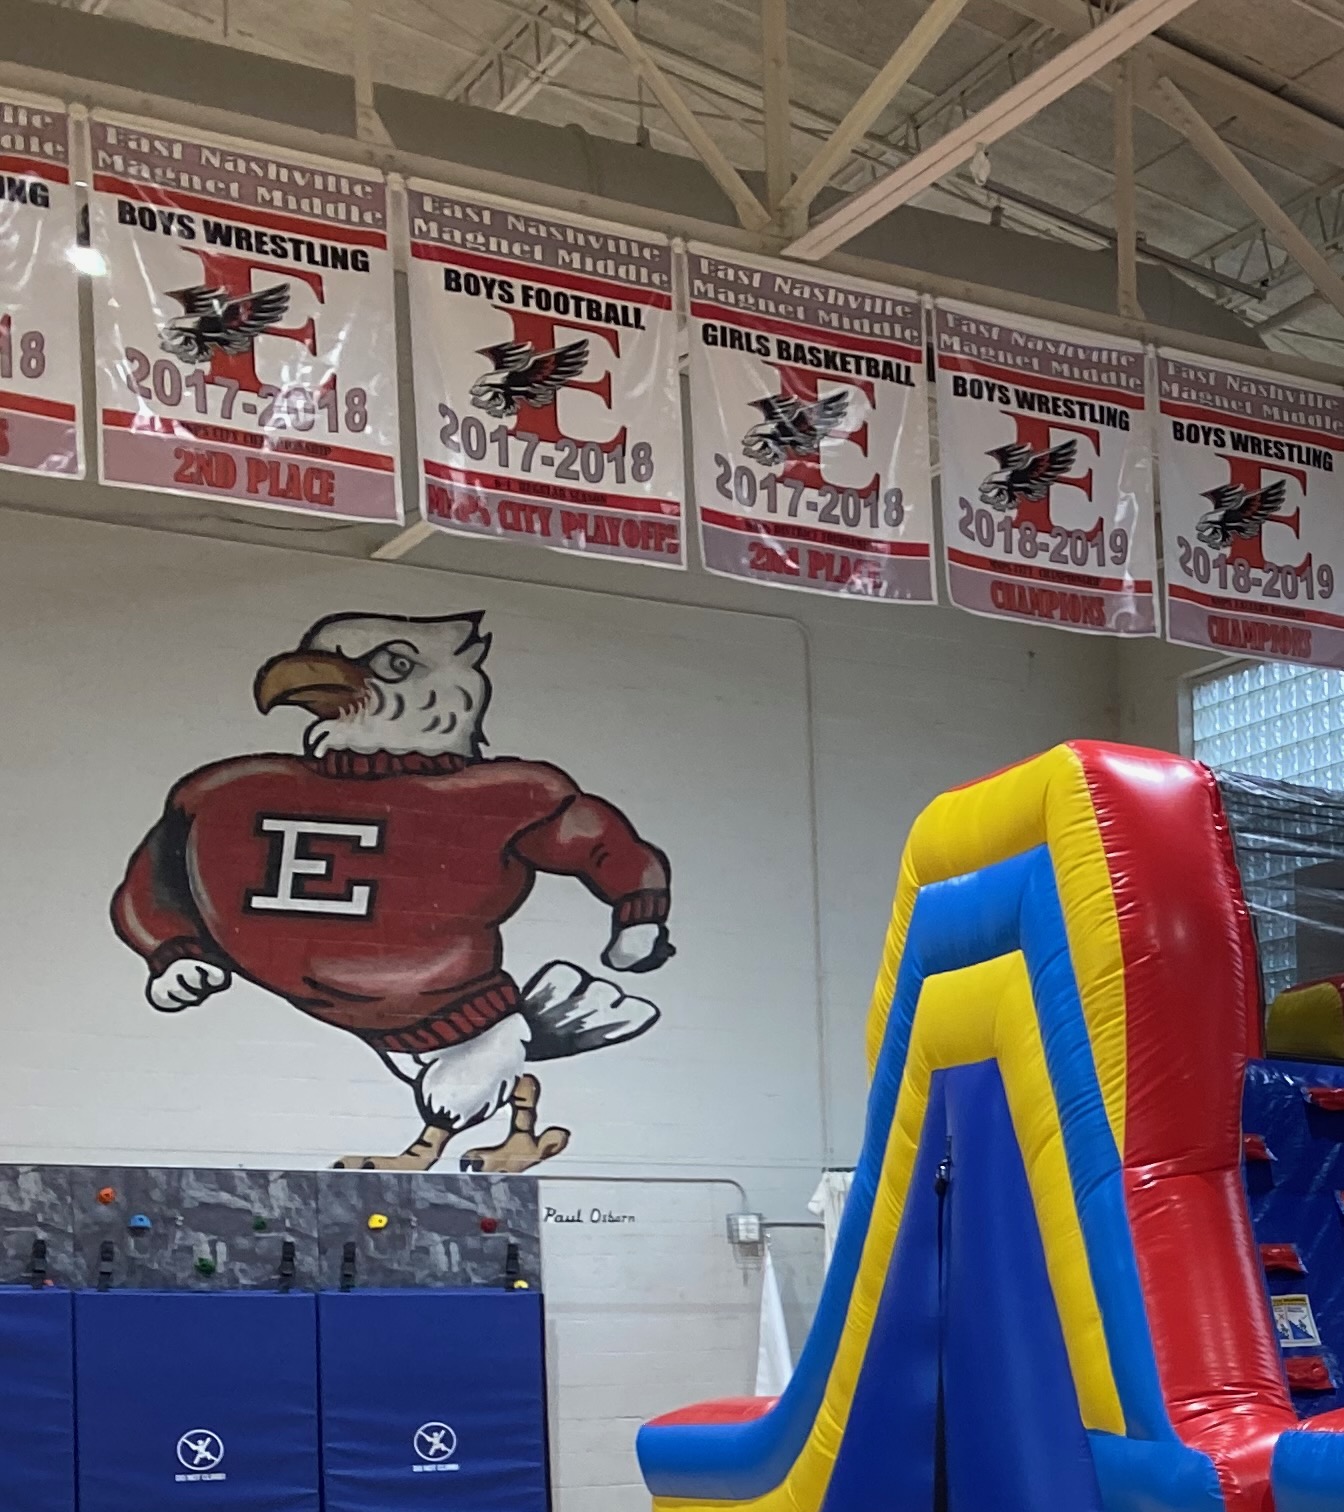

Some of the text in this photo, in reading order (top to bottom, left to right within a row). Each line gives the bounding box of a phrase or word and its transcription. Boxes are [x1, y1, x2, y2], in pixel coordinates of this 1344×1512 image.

[98, 149, 384, 226] Magnet Middle
[106, 126, 373, 200] East Nashville
[117, 198, 370, 273] BOYS WRESTLING
[413, 217, 670, 287] Magnet Middle
[422, 195, 661, 262] East Nashville
[444, 267, 646, 331] BOYS FOOTBALL
[693, 279, 919, 343] Magnet Middle
[700, 257, 912, 318] East Nashville
[702, 323, 915, 387] GIRLS BASKETBALL
[939, 333, 1142, 391] Magnet Middle
[946, 312, 1135, 367] East Nashville
[125, 346, 369, 434] 2017-2018
[953, 375, 1130, 431] BOYS WRESTLING
[1161, 380, 1344, 433] Magnet Middle
[1167, 360, 1340, 411] East Nashville
[438, 402, 654, 484] 2017-2018
[1172, 420, 1333, 472] BOYS WRESTLING
[173, 447, 335, 506] 2ND PLACE
[714, 452, 904, 528] 2017-2018
[497, 500, 552, 537] CITY
[958, 498, 1129, 567] 2018-2019
[1177, 535, 1335, 601] 2018-2019
[989, 579, 1107, 627] CHAMPIONS
[1207, 614, 1313, 659] CHAMPIONS
[246, 814, 386, 918] E
[543, 1206, 584, 1223] Paul
